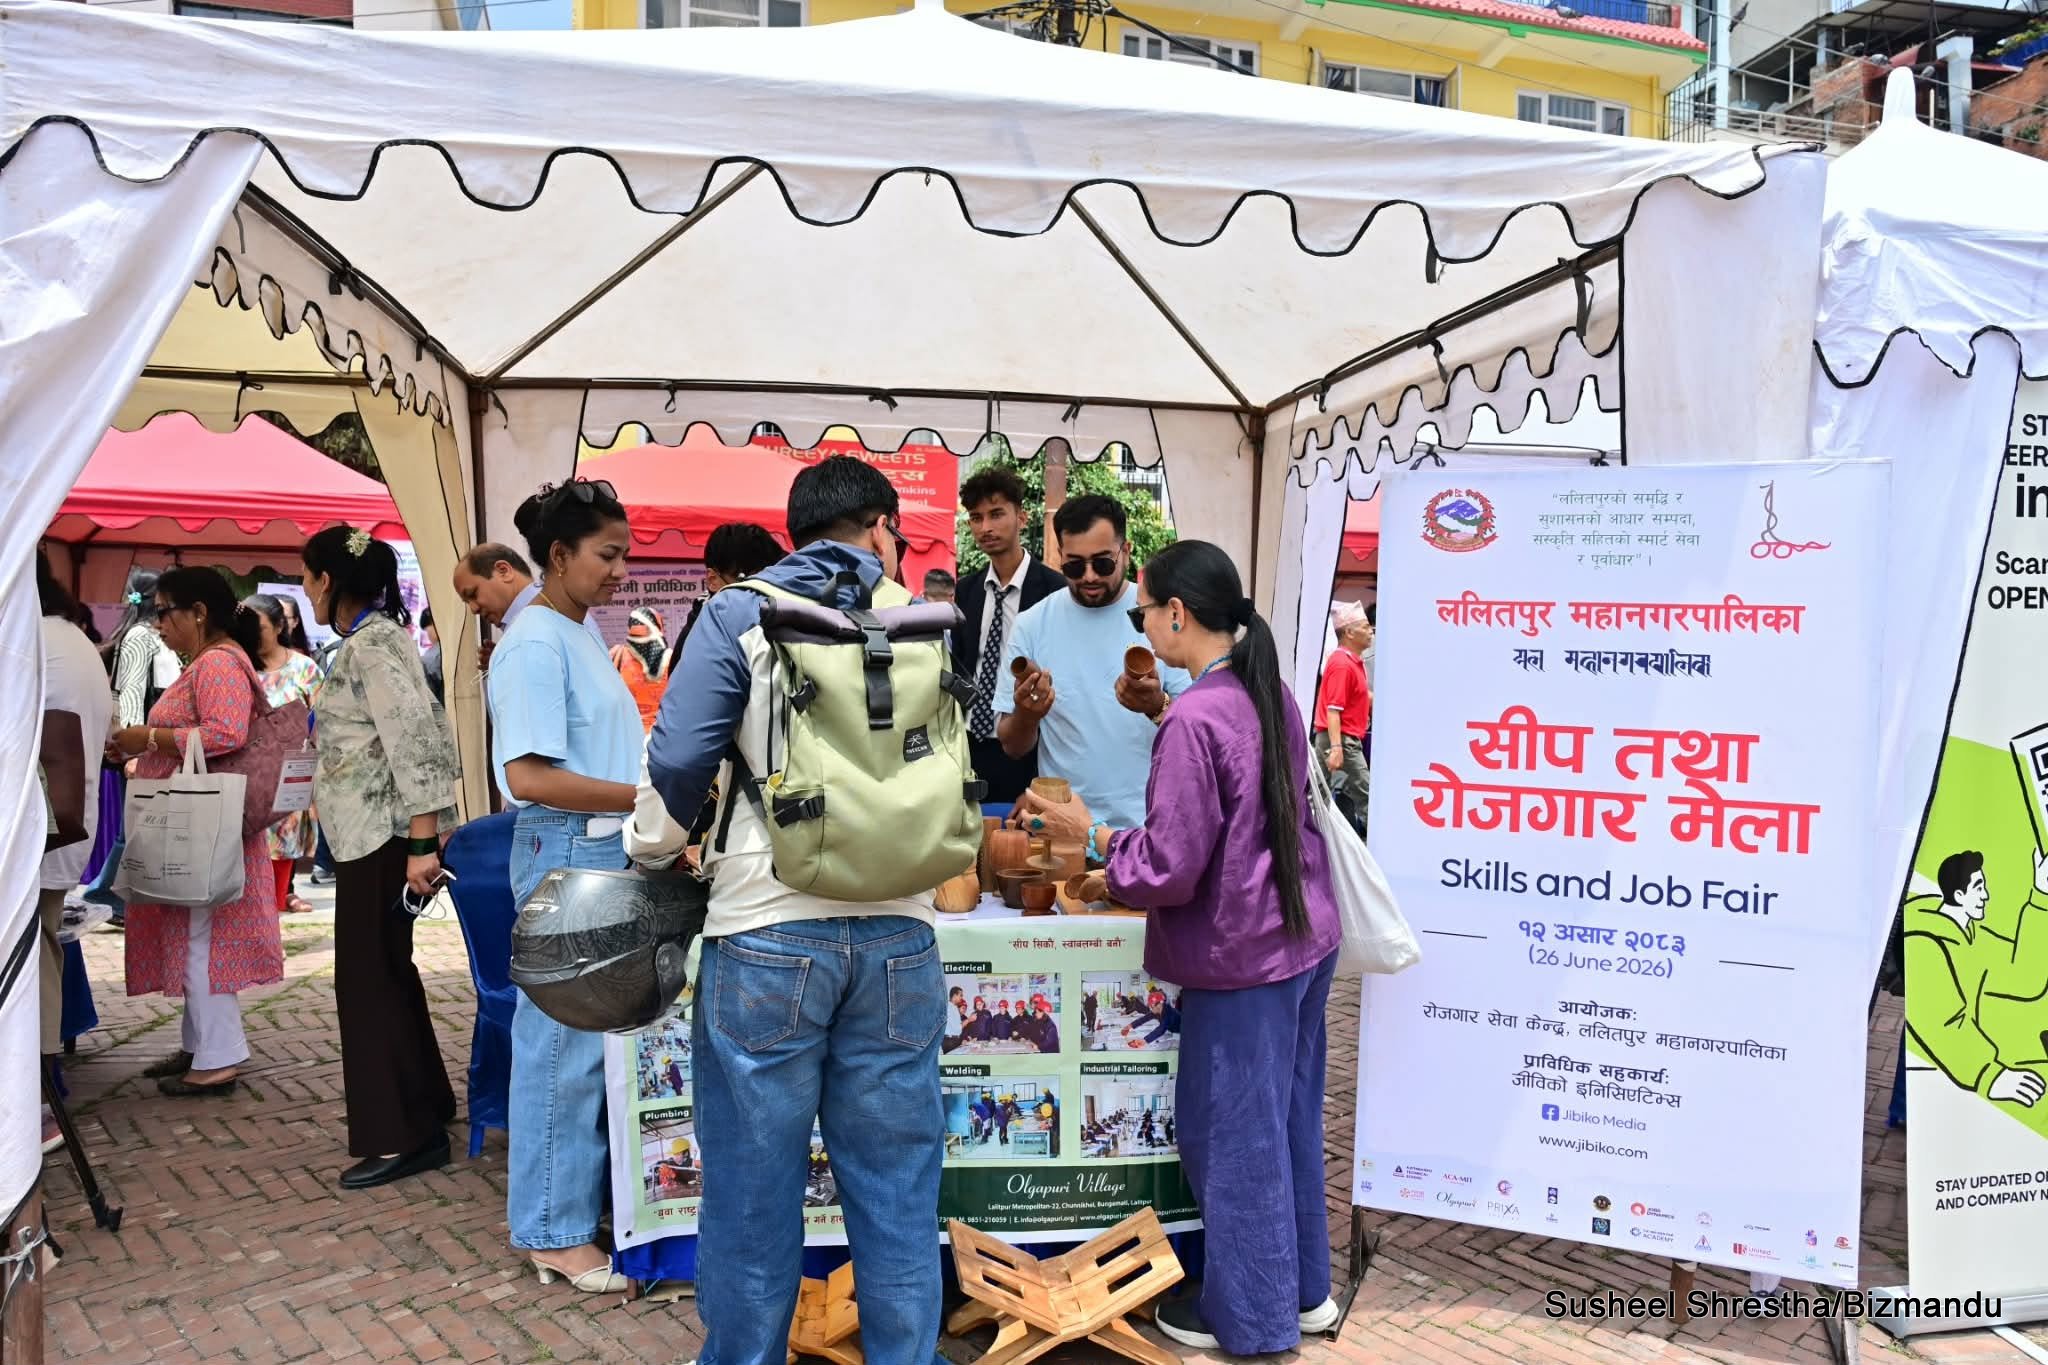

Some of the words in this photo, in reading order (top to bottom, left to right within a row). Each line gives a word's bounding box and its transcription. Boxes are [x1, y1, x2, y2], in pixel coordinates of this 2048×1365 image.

[1609, 513, 1644, 526] आधार
[1437, 591, 1555, 637] ललितपुर
[1569, 594, 1806, 634] महानगरपालिका
[1467, 705, 1594, 773] सीप
[1613, 728, 1760, 784] तथा
[1411, 762, 1647, 842] रोजगार
[1668, 777, 1821, 854] मेला
[1440, 858, 1528, 894] Skills
[1536, 870, 1611, 901] and
[1620, 874, 1692, 908] Job
[1703, 880, 1779, 915] Fair
[1518, 919, 1546, 942] १२
[1554, 922, 1618, 947] असार
[1625, 929, 1687, 957] २०८३
[945, 963, 986, 973] Electrical
[1528, 944, 1559, 967] (26
[1563, 950, 1613, 973] June
[1616, 953, 1674, 979] 2026)
[1558, 999, 1637, 1022] आयोजक:
[1423, 1002, 1480, 1024] रोजगार
[1487, 1009, 1518, 1029] सेवा
[1525, 1013, 1570, 1038] केन्द्र,
[1579, 1021, 1647, 1048] ललितपुर
[1656, 1032, 1788, 1062] महानगरपालिका
[945, 1065, 983, 1077] Welding
[1083, 1064, 1120, 1073] Industrial
[1122, 1064, 1158, 1074] Tailoring
[1523, 1052, 1592, 1075] प्राविधिक
[1599, 1064, 1670, 1086] सहकार्य:
[1512, 1071, 1567, 1094] जीविको
[645, 1108, 690, 1121] Plumbing
[1562, 1108, 1601, 1126] Jibiko
[1603, 1115, 1648, 1132] Media
[1538, 1135, 1649, 1160] www.jibiko.com
[1007, 1173, 1071, 1200] Olgapuri
[1076, 1172, 1126, 1197] Village
[1936, 1177, 1967, 1193] STAY
[1970, 1172, 2032, 1189] UPDATED
[1936, 1196, 1964, 1211] AND
[1967, 1189, 2037, 1207] COMPANY
